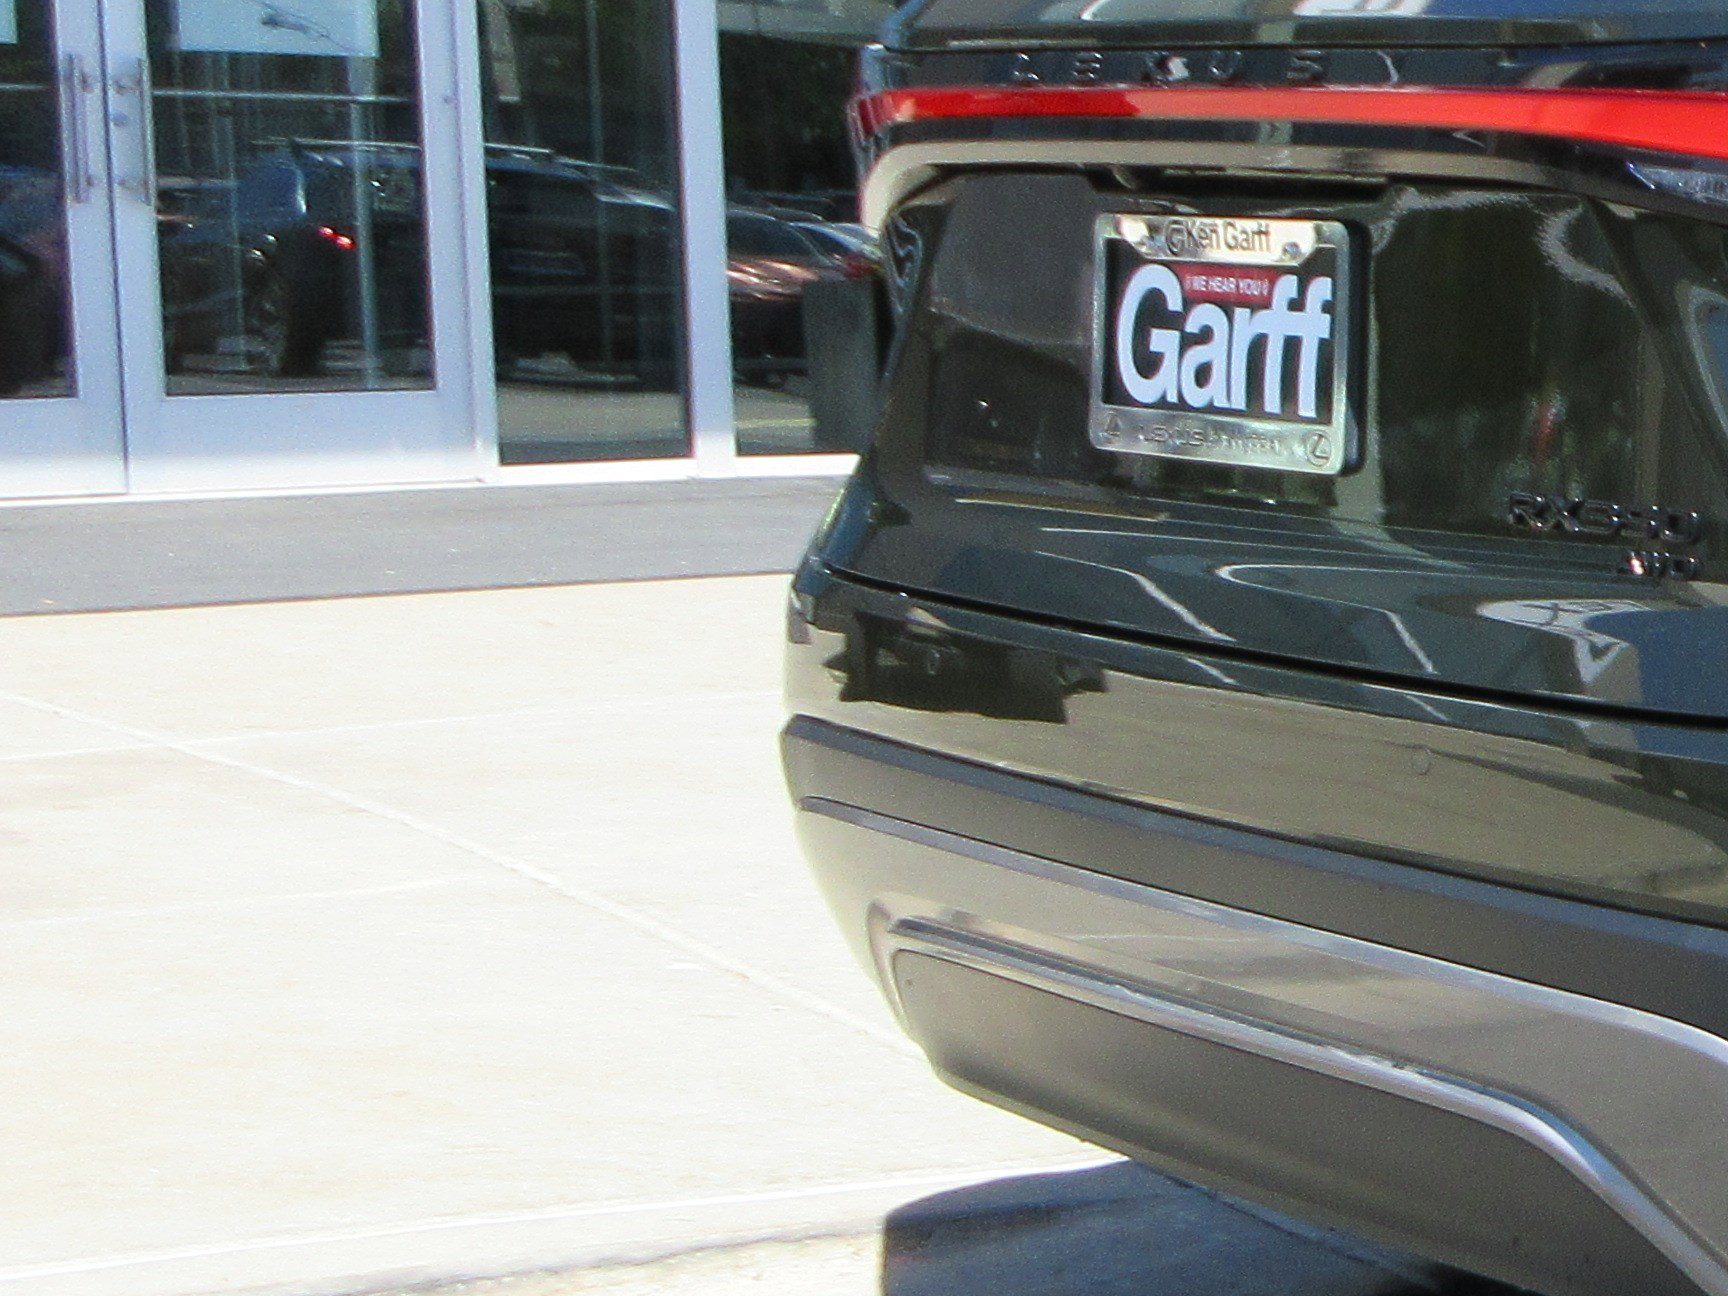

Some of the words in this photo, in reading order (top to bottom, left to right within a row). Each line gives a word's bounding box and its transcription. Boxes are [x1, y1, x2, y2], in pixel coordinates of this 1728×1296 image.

[1011, 49, 1324, 83] LEXUS
[1185, 219, 1220, 250] Ken
[1222, 221, 1271, 252] Garff
[1116, 263, 1332, 418] Garff
